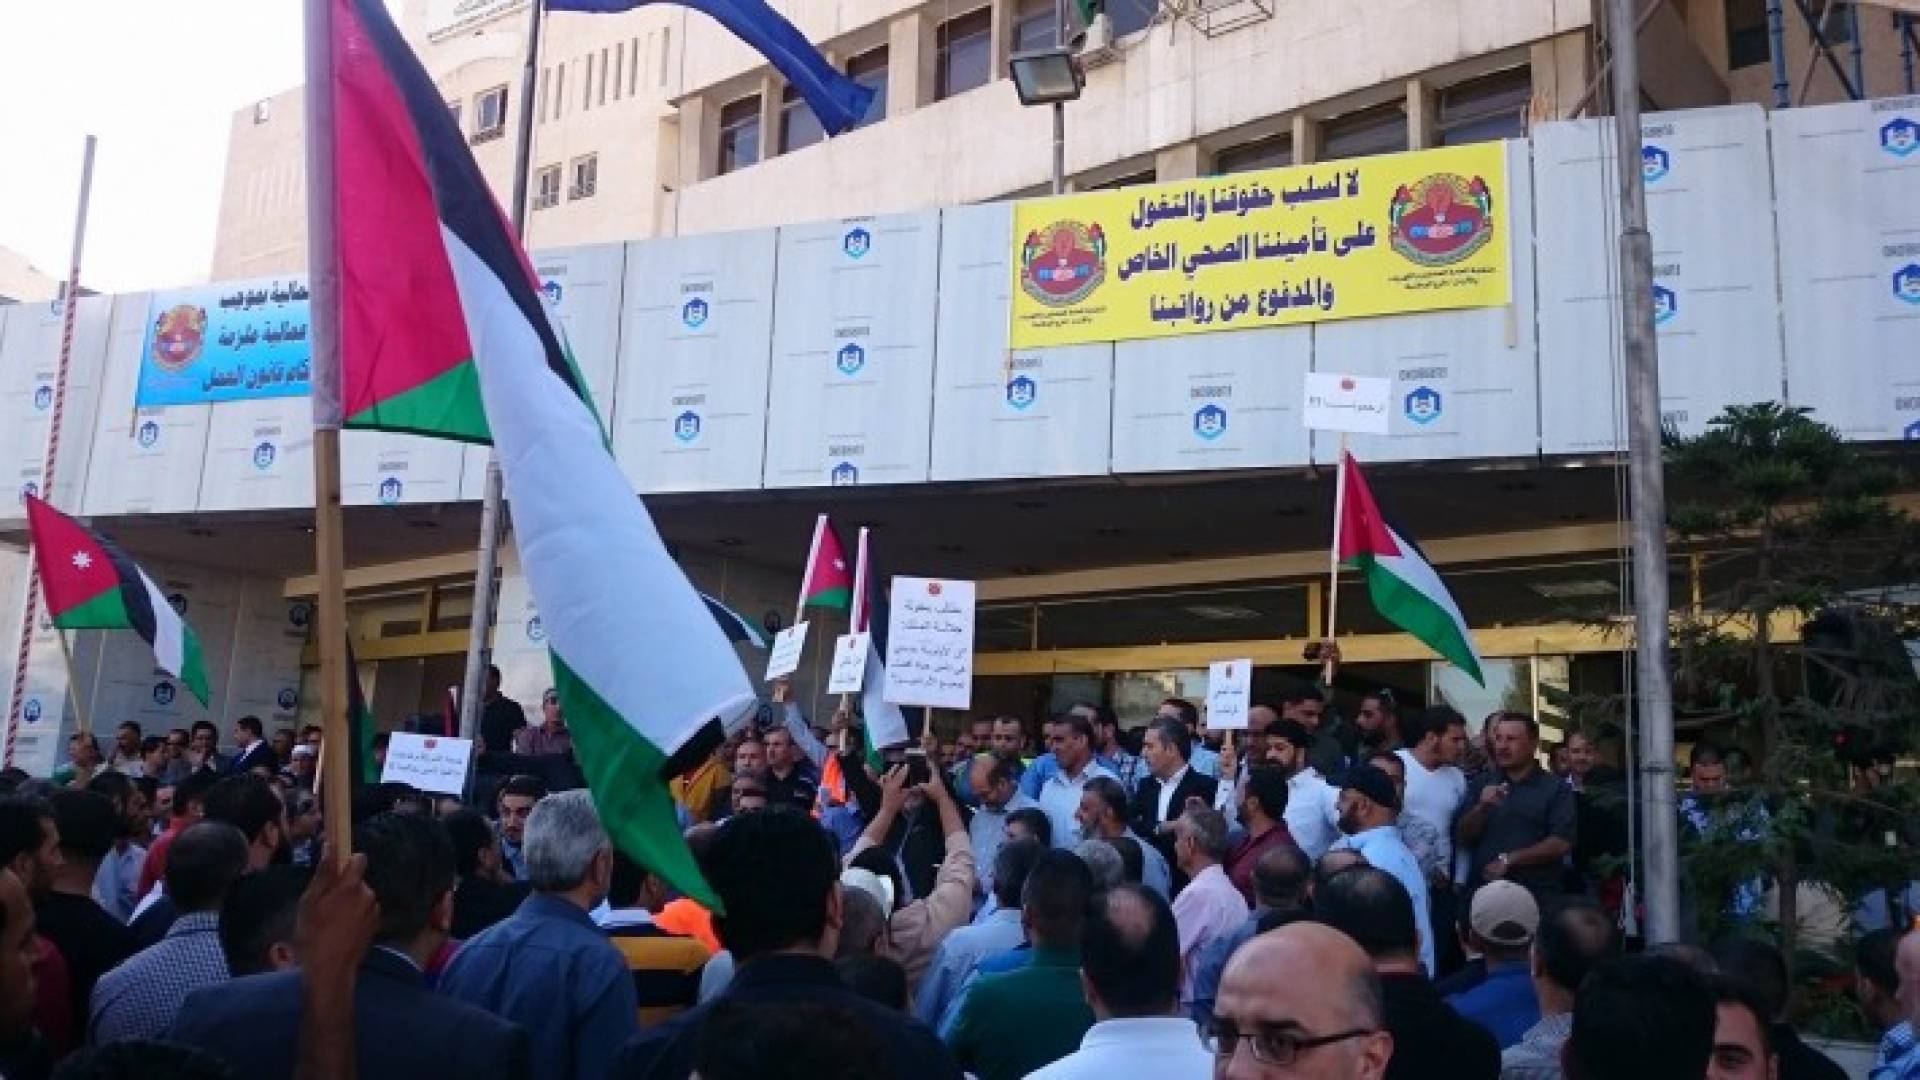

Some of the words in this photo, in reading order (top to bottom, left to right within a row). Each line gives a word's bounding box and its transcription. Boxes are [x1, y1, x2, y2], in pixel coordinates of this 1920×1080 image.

[1211, 180, 1275, 216] حقوقنا
[1282, 171, 1340, 212] لسلب
[1345, 167, 1359, 197] لا
[1131, 189, 1206, 229] والتغول
[1182, 231, 1249, 281] الصحي
[1252, 216, 1327, 263] تأميننا
[1333, 220, 1375, 257] على
[1118, 241, 1177, 281] الخاص
[1150, 290, 1214, 327] رواتبنا
[1220, 292, 1249, 322] من
[1257, 275, 1335, 317] والمدفوع
[202, 363, 246, 393] العمل
[244, 361, 285, 390] قانون
